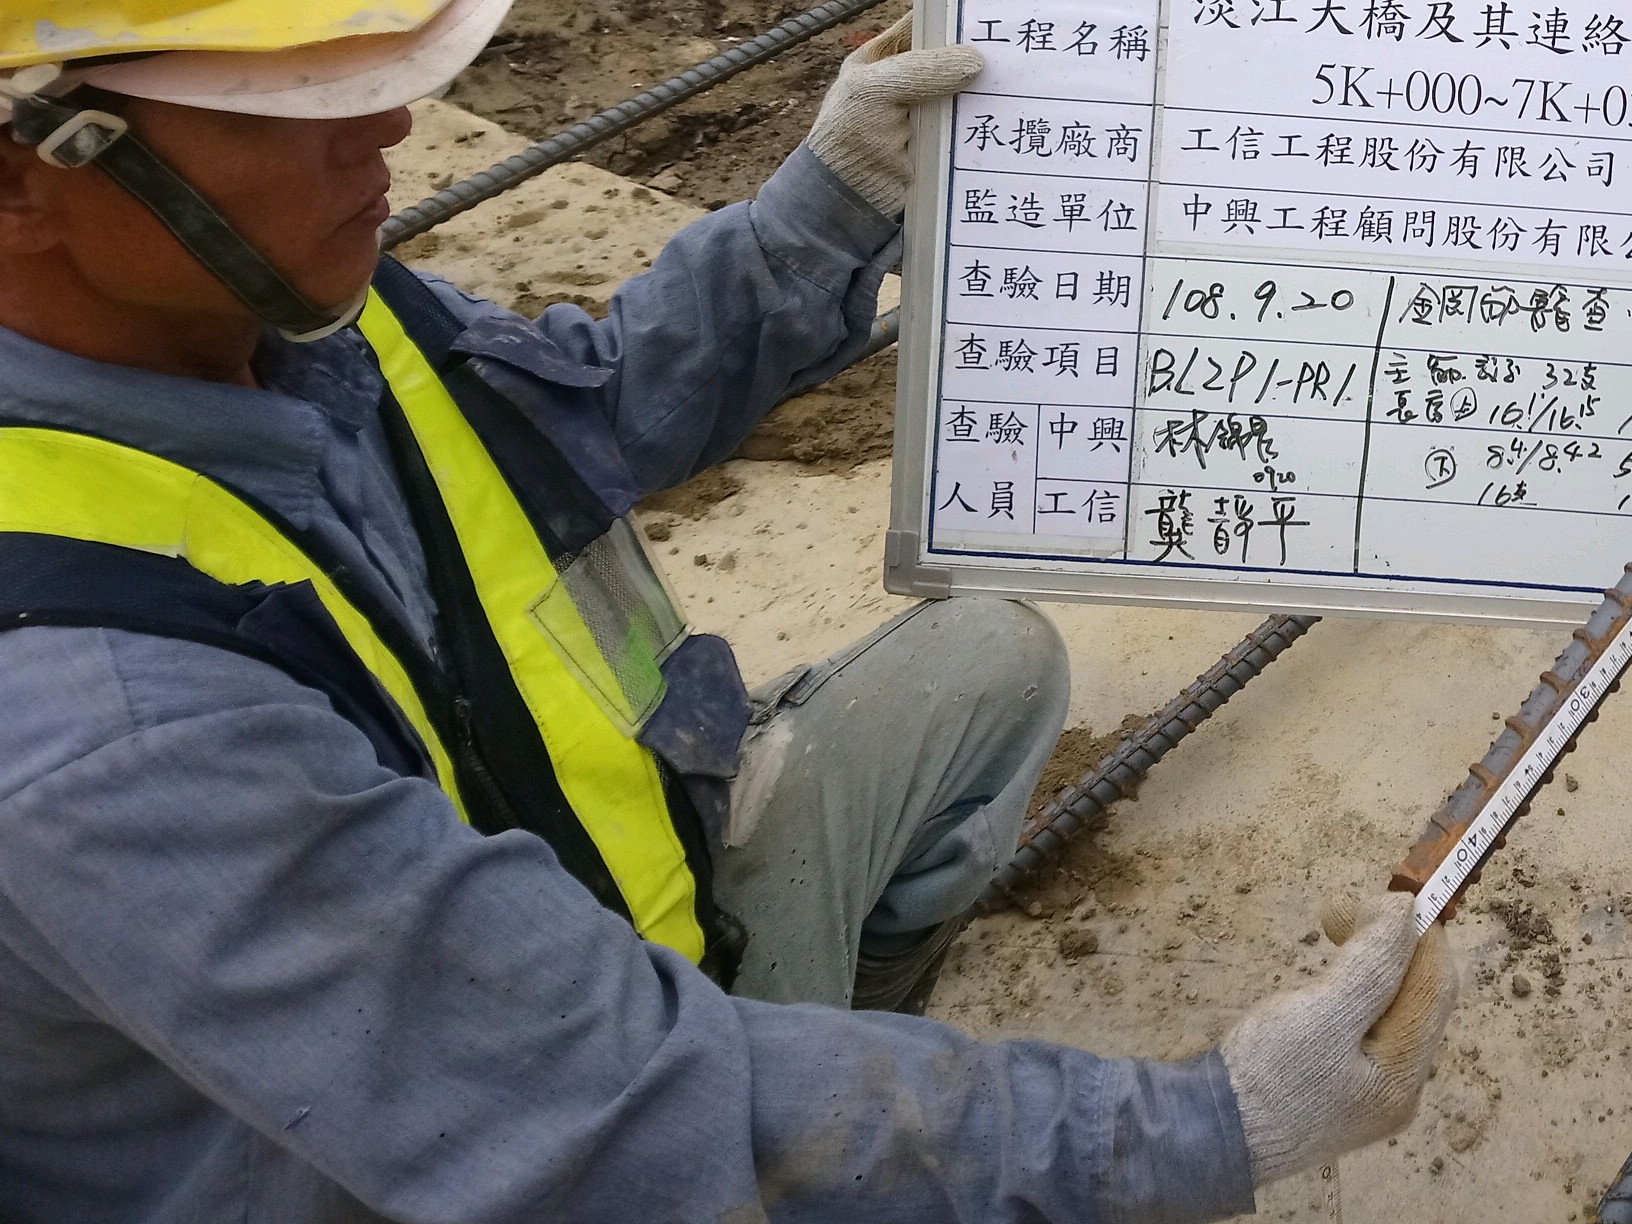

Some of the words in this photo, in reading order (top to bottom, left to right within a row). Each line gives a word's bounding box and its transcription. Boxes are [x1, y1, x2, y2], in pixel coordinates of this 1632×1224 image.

[970, 18, 1151, 63] 工程名稱
[964, 114, 1143, 162] 承攬廠商
[1180, 125, 1615, 188] 工信工程股份有限公司
[960, 188, 1138, 233] 監造單位
[959, 259, 1131, 308] 查驗日期
[1162, 279, 1355, 323] 108.9.20
[954, 332, 1120, 378] 查驗項目
[945, 405, 1029, 446] 查驗
[1048, 411, 1128, 452] 中興
[938, 481, 1016, 520] 人員
[1037, 489, 1121, 523] 工信
[1571, 686, 1591, 711] 30
[1457, 833, 1478, 862] 40
